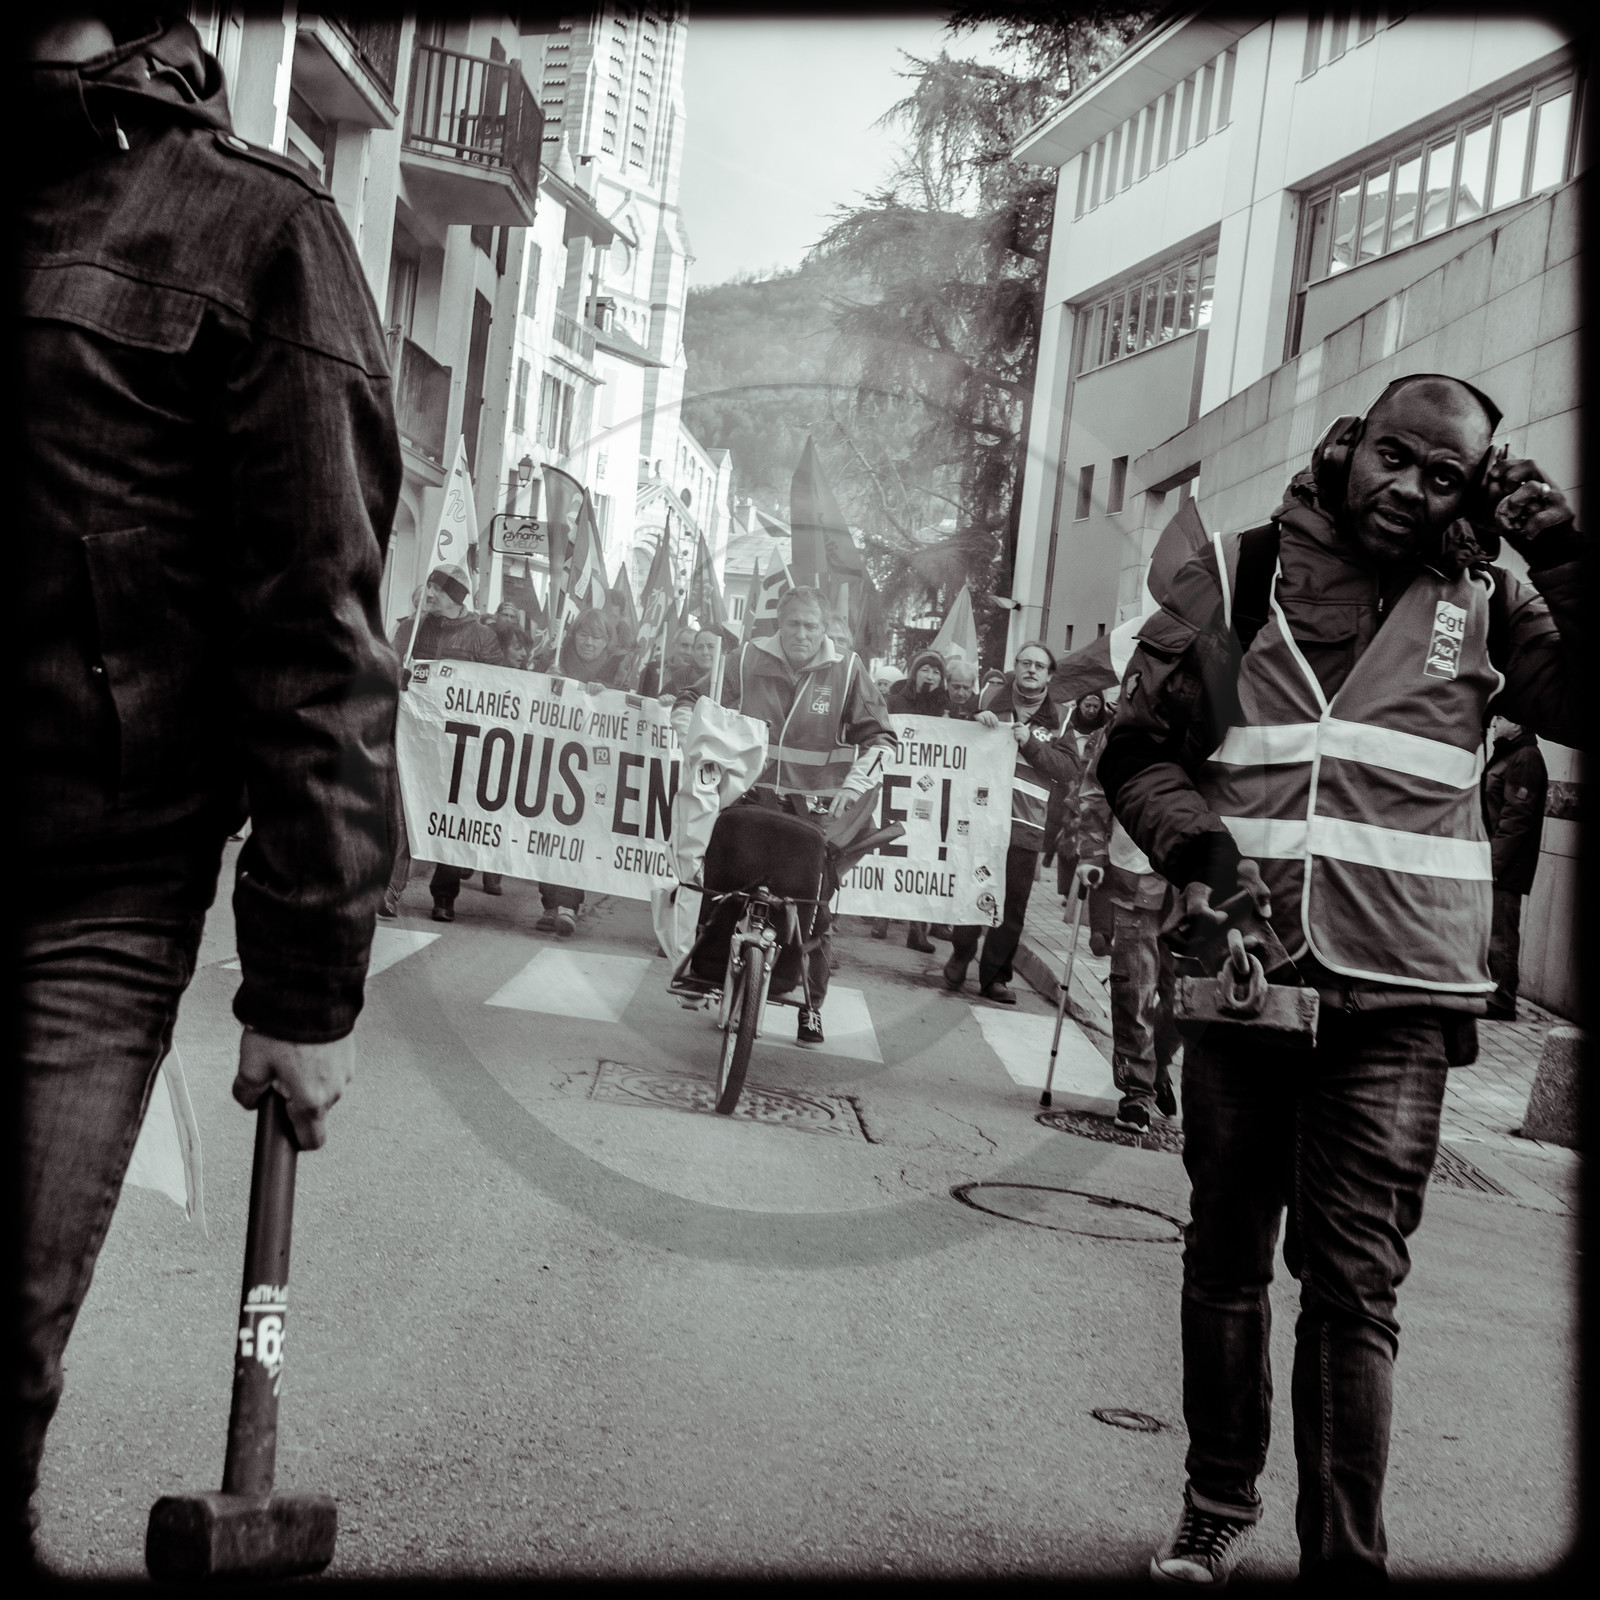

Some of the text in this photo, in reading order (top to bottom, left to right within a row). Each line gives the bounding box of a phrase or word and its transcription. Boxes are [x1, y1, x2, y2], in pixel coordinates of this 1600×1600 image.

[1437, 612, 1465, 633] cgt
[444, 685, 521, 721] SALARIÉS
[812, 702, 830, 713] cgt
[596, 749, 609, 761] FO
[895, 741, 967, 770] D'EMPLOI
[444, 720, 680, 842] TOUS EN
[427, 812, 502, 848] SALAIRES
[527, 830, 585, 863] EMPLOI
[894, 869, 956, 898] SOCIALE
